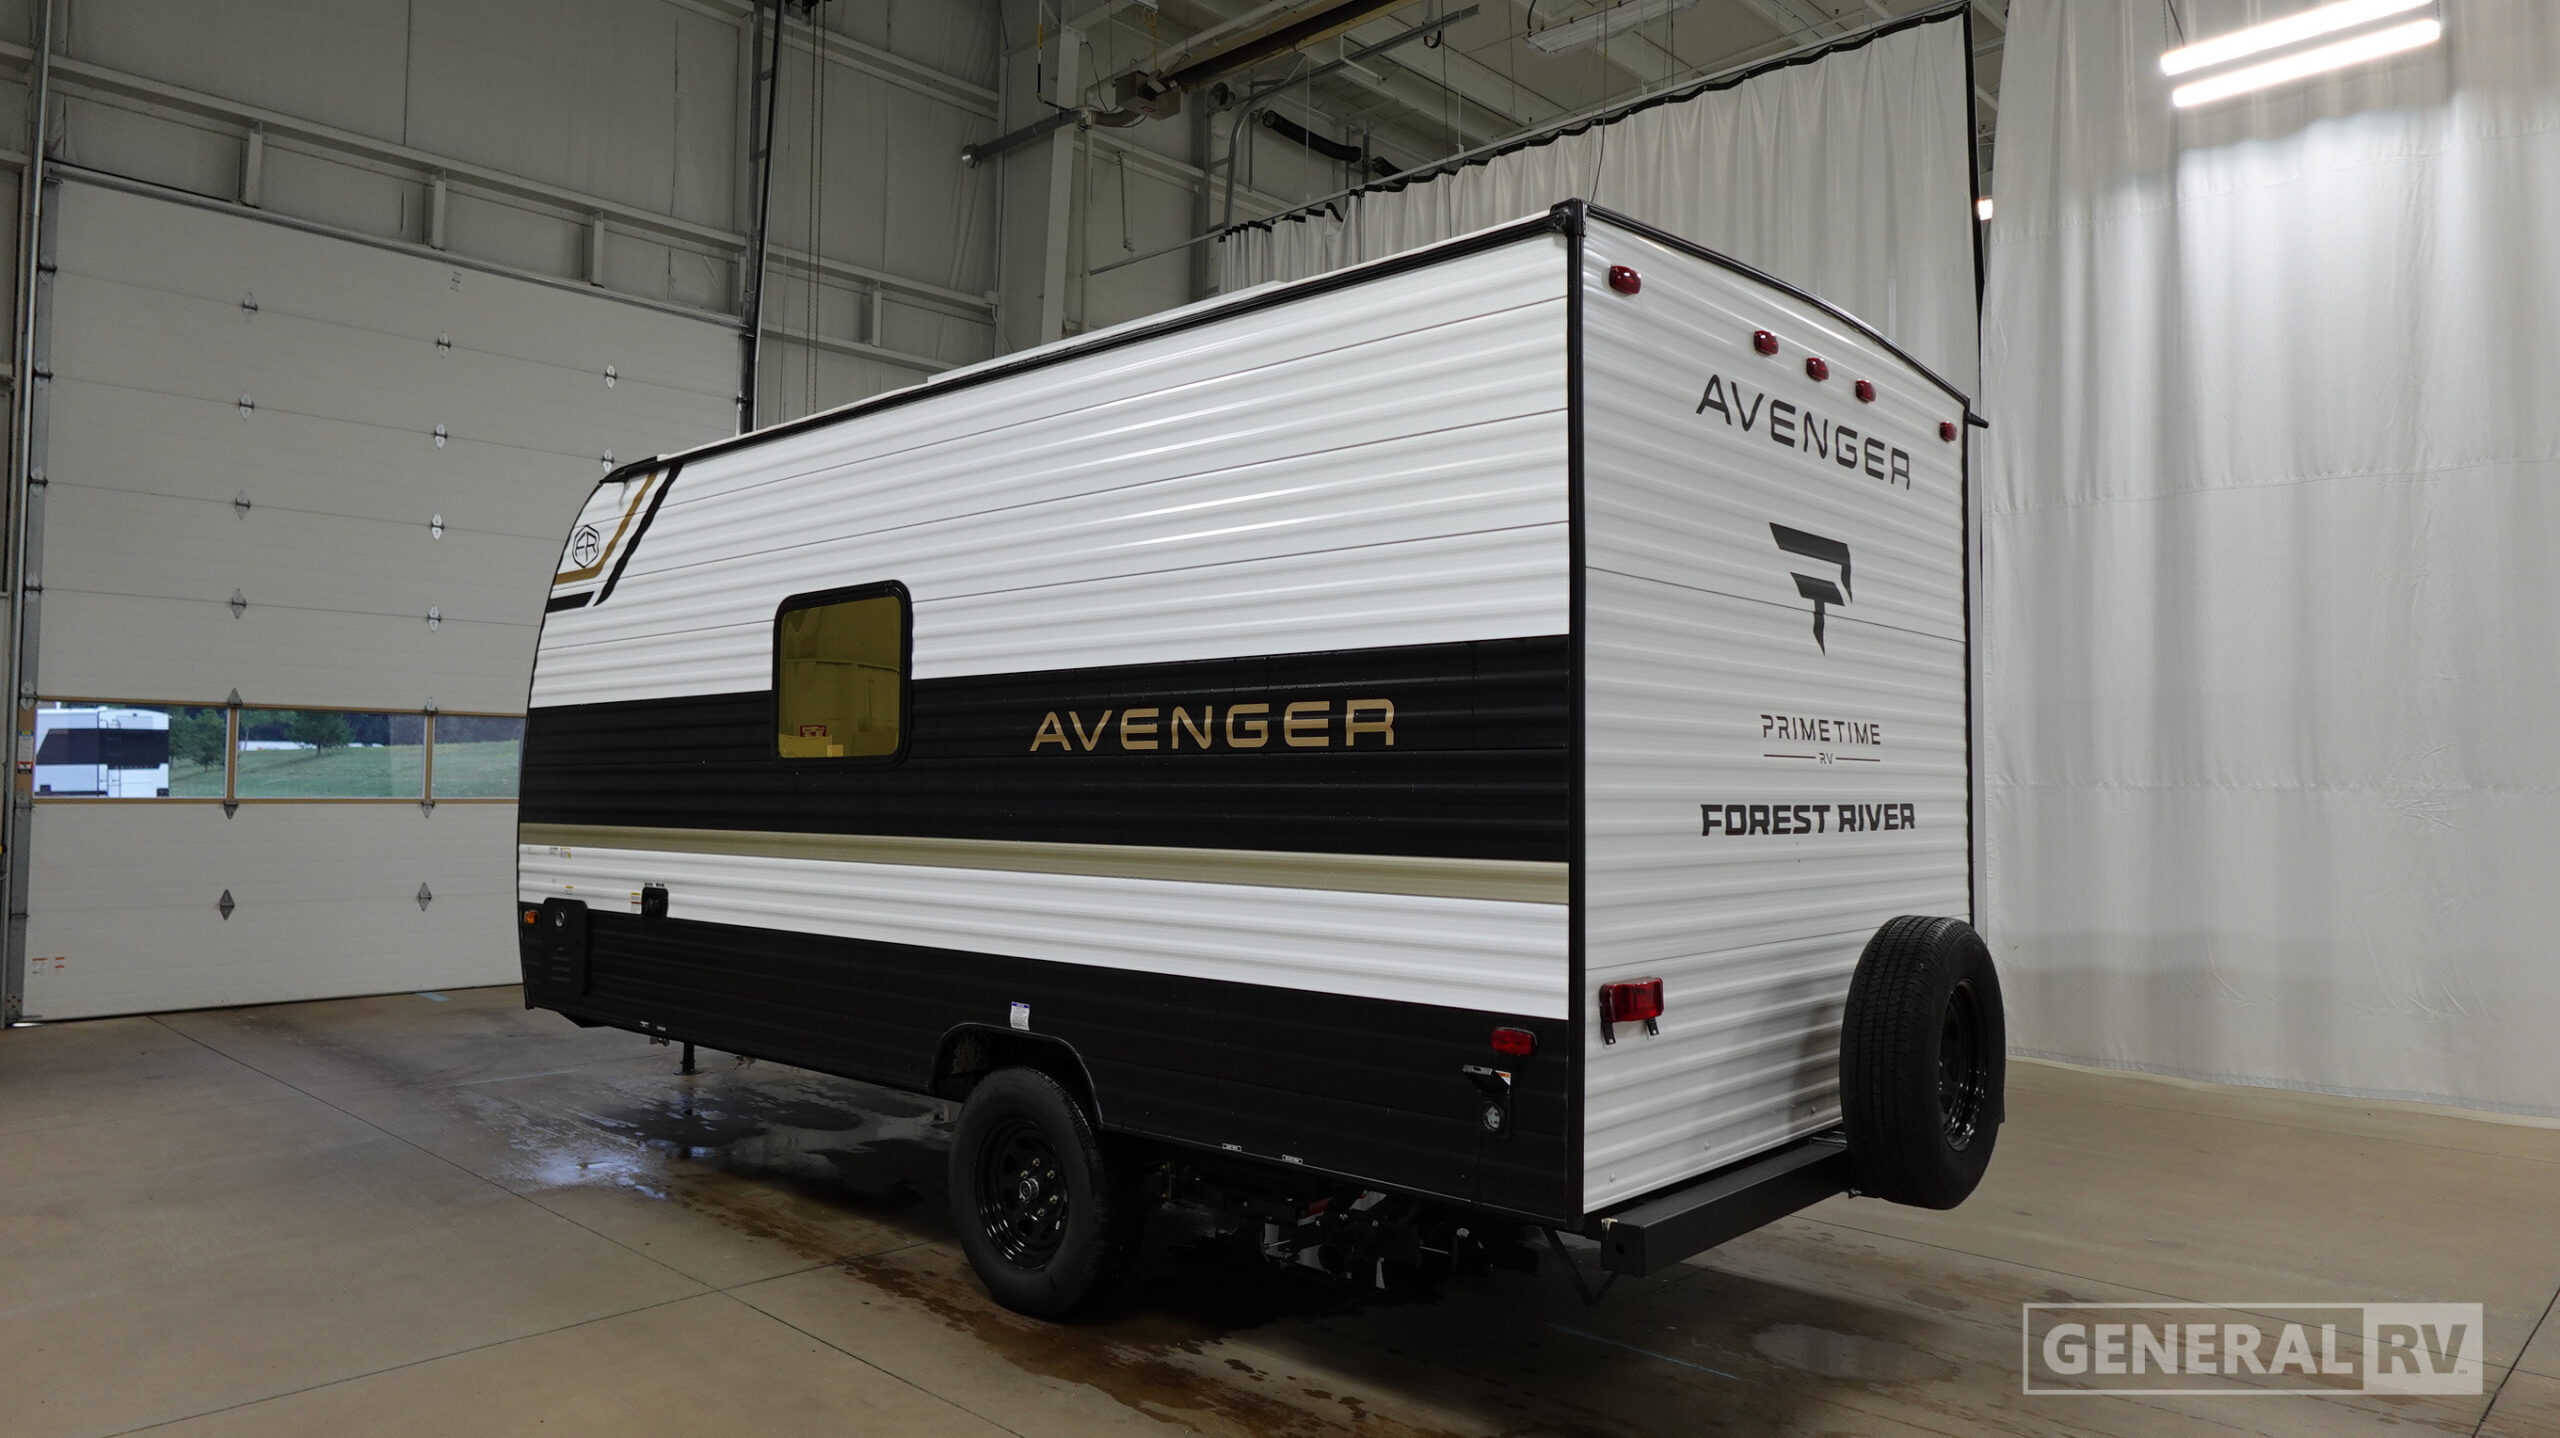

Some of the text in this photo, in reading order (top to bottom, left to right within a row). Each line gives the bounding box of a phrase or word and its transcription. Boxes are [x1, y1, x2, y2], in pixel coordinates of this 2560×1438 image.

[1696, 374, 1910, 490] AVENGER
[1029, 698, 1395, 752] AVENGER
[1818, 752, 1834, 765] RV
[1700, 803, 1916, 836] FOREST RIVER
